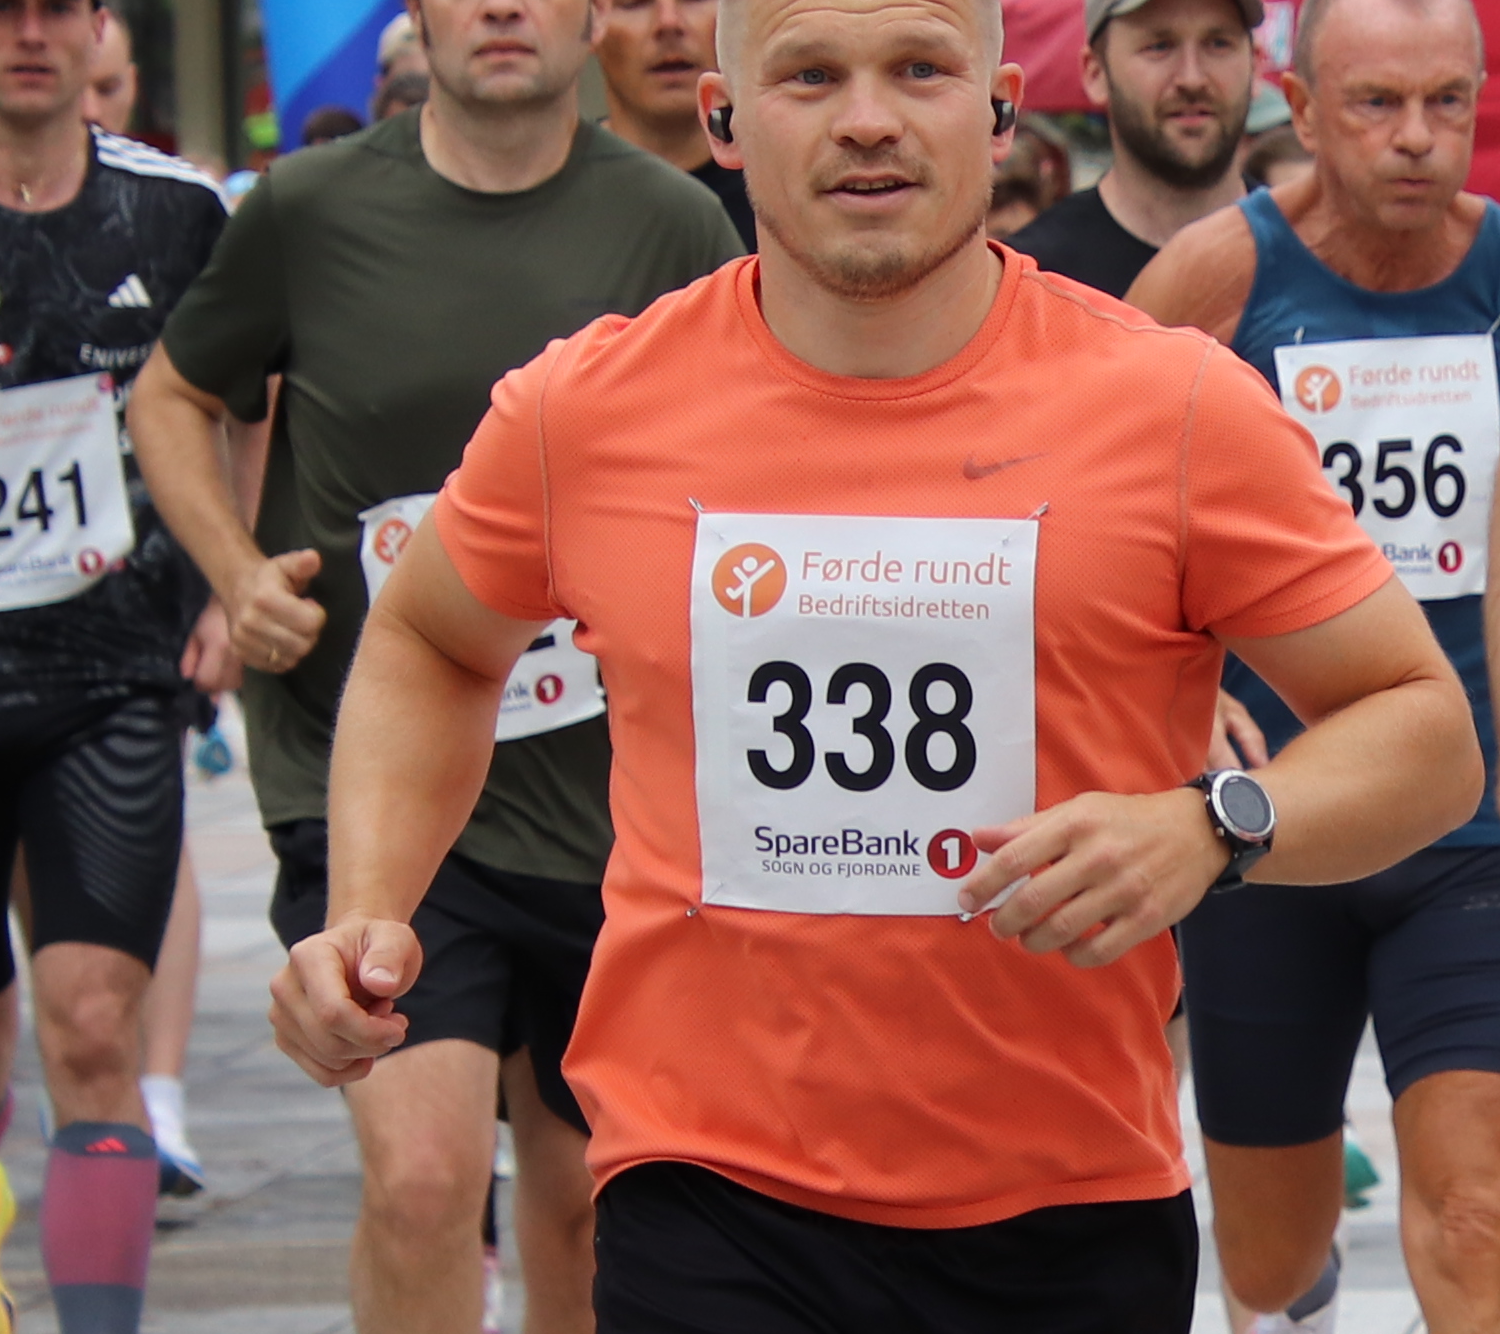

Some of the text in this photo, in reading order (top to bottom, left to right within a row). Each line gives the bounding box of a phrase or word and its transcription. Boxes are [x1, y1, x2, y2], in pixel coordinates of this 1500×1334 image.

[1419, 358, 1481, 382] rundt
[1322, 434, 1466, 519] 356
[801, 550, 1012, 586] Førde rundt
[799, 594, 990, 620] Bedriftsidretten
[746, 660, 978, 792] 338
[754, 826, 920, 858] SpareBank
[761, 860, 921, 878] SOGN OG FJORDANE
